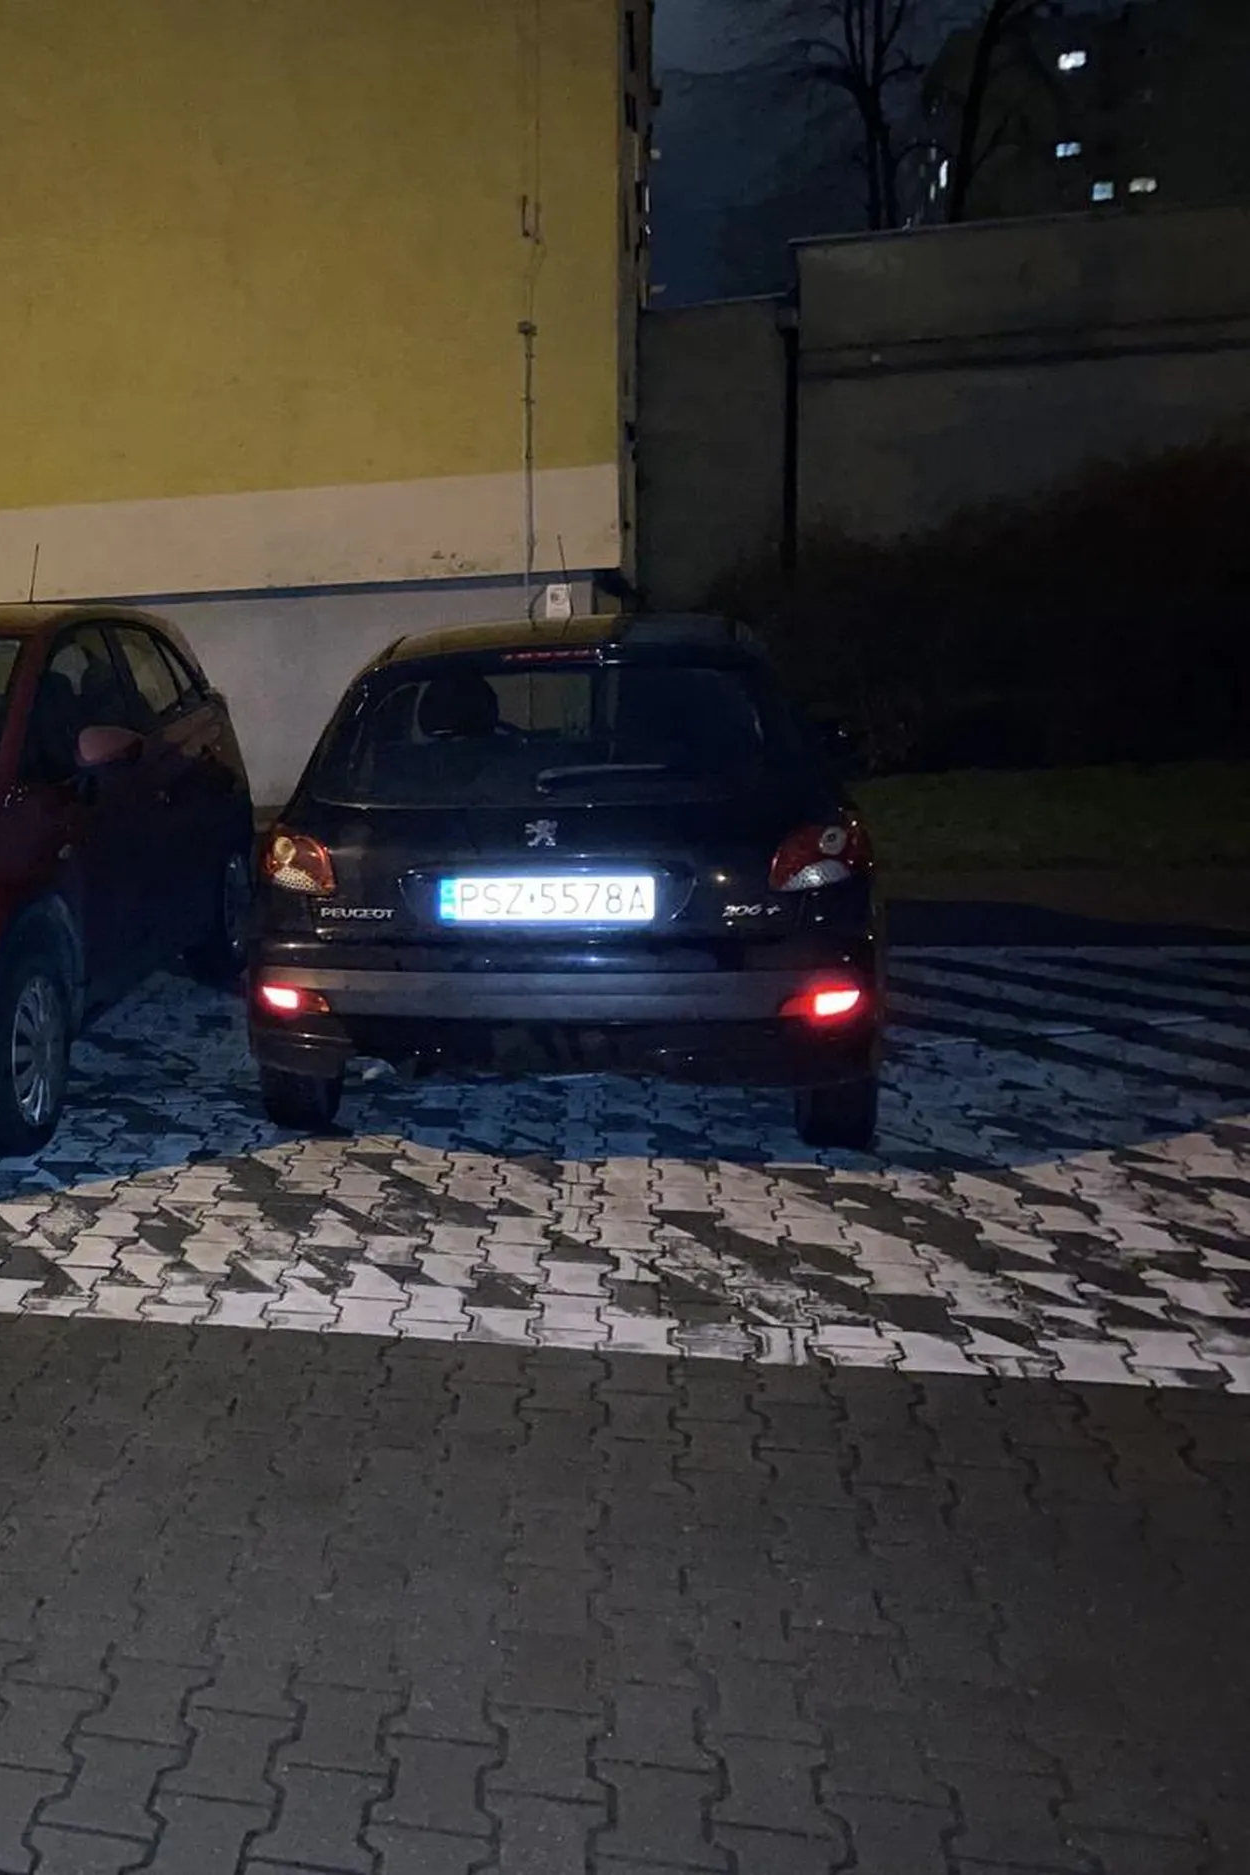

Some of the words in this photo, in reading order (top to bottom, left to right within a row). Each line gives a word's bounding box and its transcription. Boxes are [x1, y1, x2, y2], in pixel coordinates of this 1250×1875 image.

[460, 883, 523, 915] PSZ
[540, 883, 647, 915] 5578A
[321, 907, 395, 919] PEUGEOT
